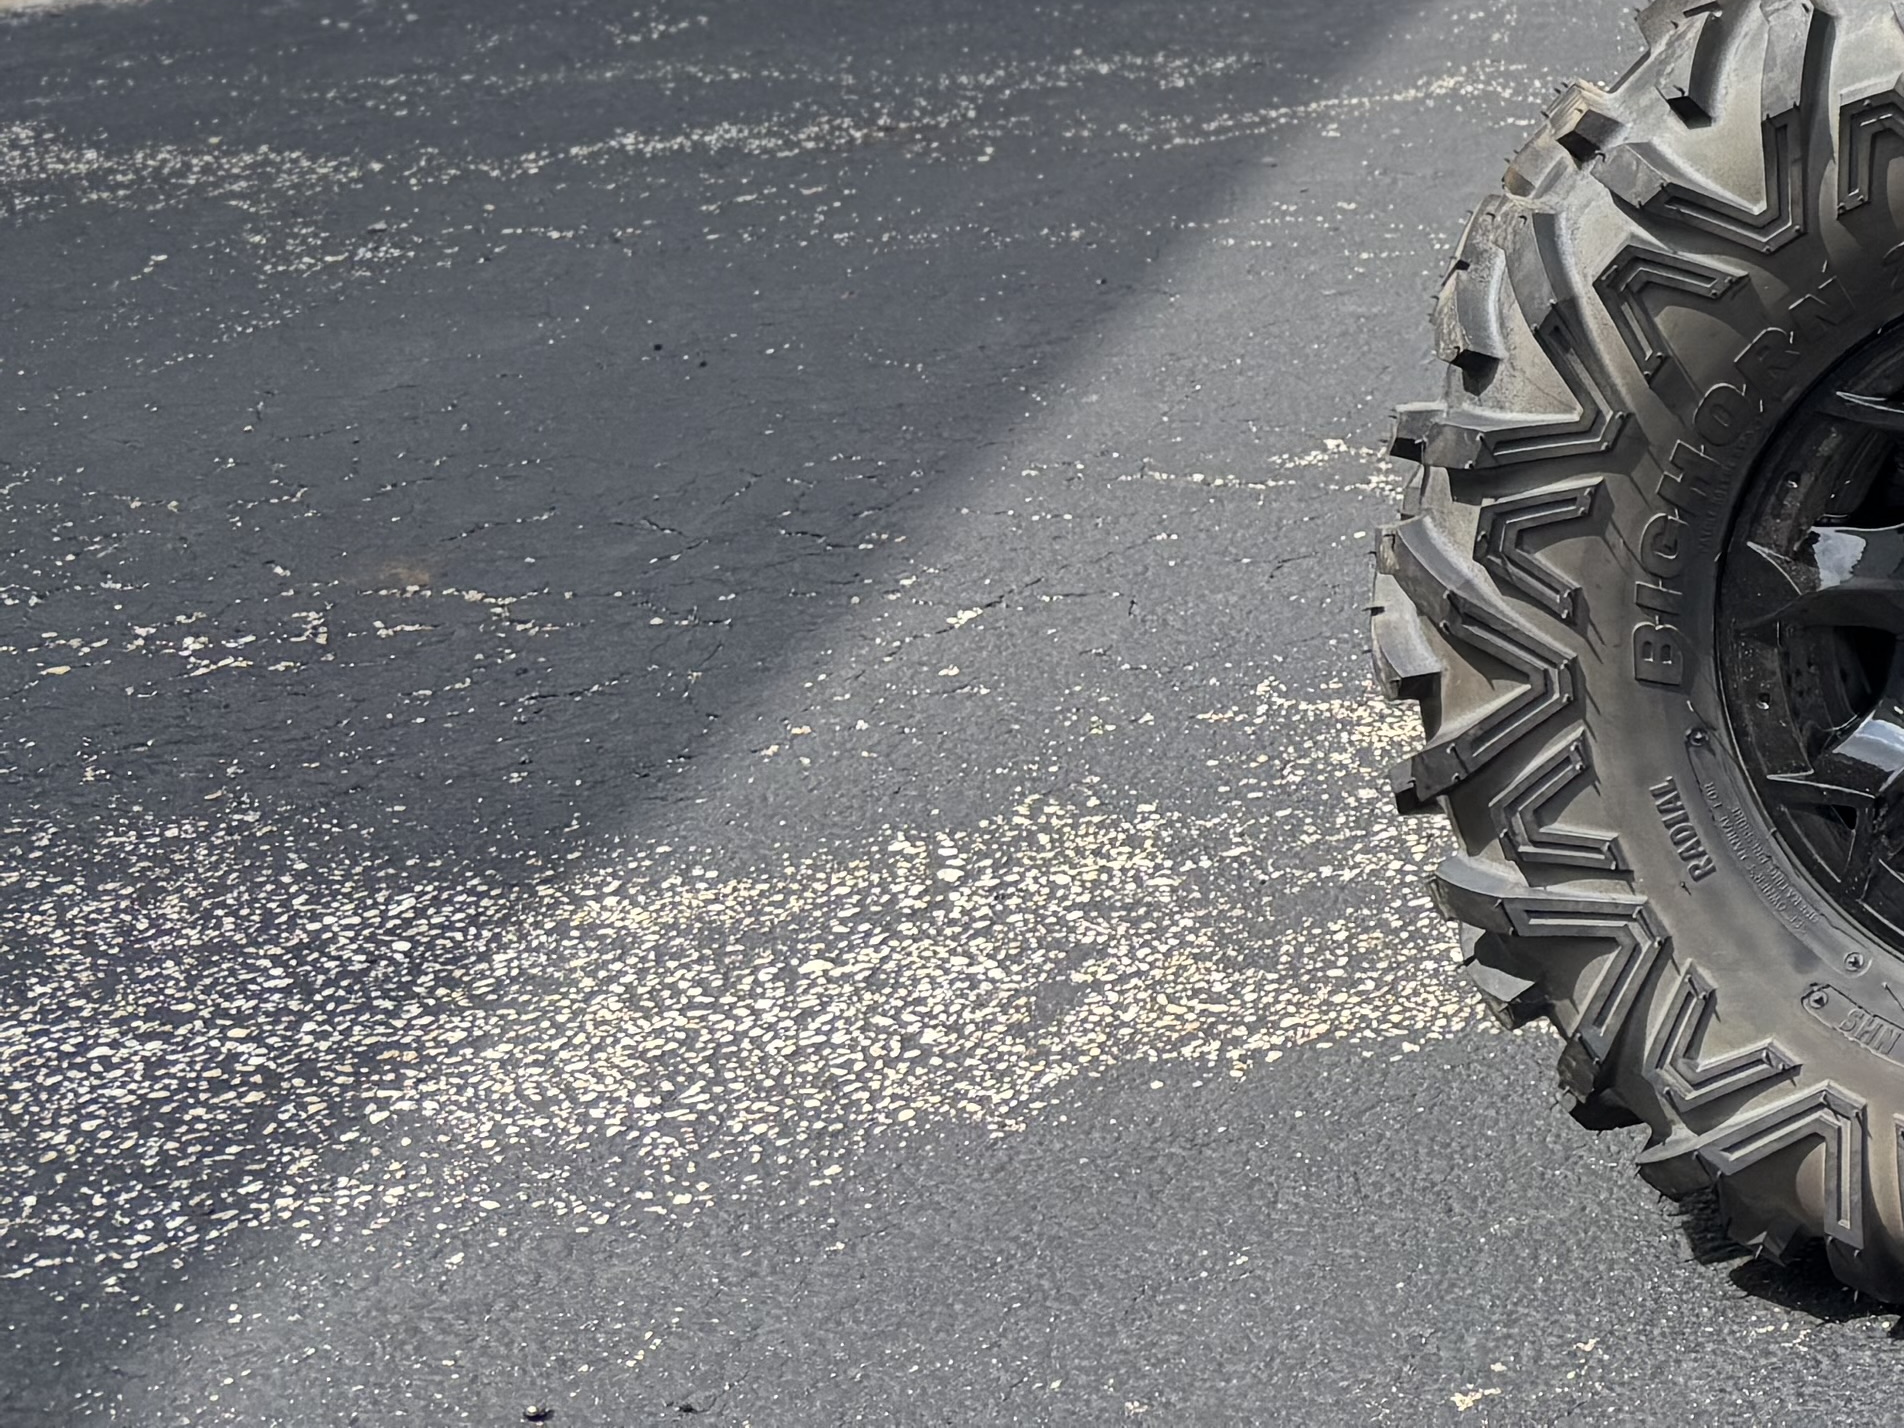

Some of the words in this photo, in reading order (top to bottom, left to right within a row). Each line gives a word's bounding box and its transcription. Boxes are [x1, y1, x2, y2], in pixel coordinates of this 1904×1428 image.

[1633, 276, 1858, 686] BIGHORN
[1648, 775, 1718, 883] RADIAL
[1838, 1006, 1902, 1057] NHS
